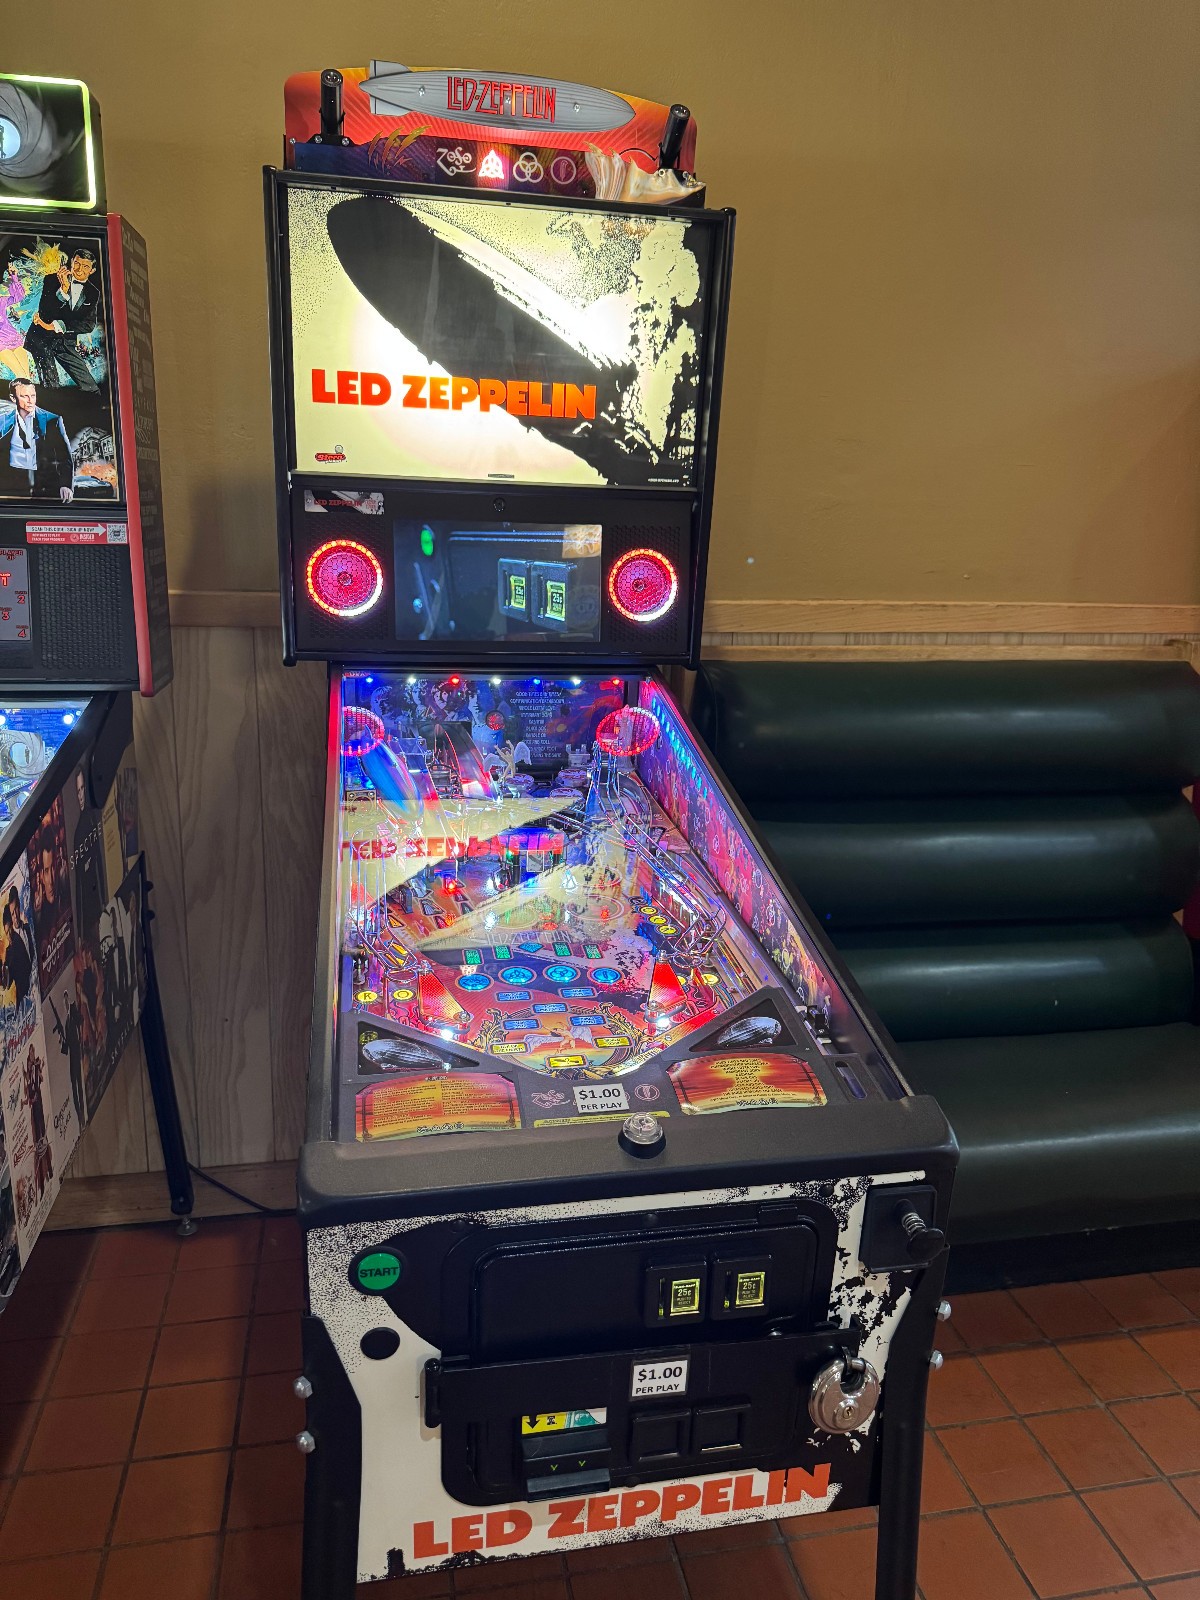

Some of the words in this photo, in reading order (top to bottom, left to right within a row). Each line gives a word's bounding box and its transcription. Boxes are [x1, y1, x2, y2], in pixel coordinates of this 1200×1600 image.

[311, 368, 392, 407] LED
[402, 374, 597, 420] ZEPPELIN
[17, 595, 26, 604] 2
[1, 611, 10, 620] 3
[18, 629, 26, 638] 4
[69, 822, 102, 870] SPECTRE
[578, 1088, 621, 1101] $1.00
[581, 1103, 599, 1111] PER
[600, 1101, 623, 1110] PLAY
[360, 1266, 399, 1278] START
[742, 1281, 756, 1290] 25¢
[677, 1288, 692, 1297] 25¢
[637, 1365, 683, 1383] $1.00
[635, 1386, 654, 1395] PER
[656, 1383, 680, 1393] PLAY
[412, 1508, 533, 1560] LED
[546, 1462, 833, 1540] ZEPPELIN
